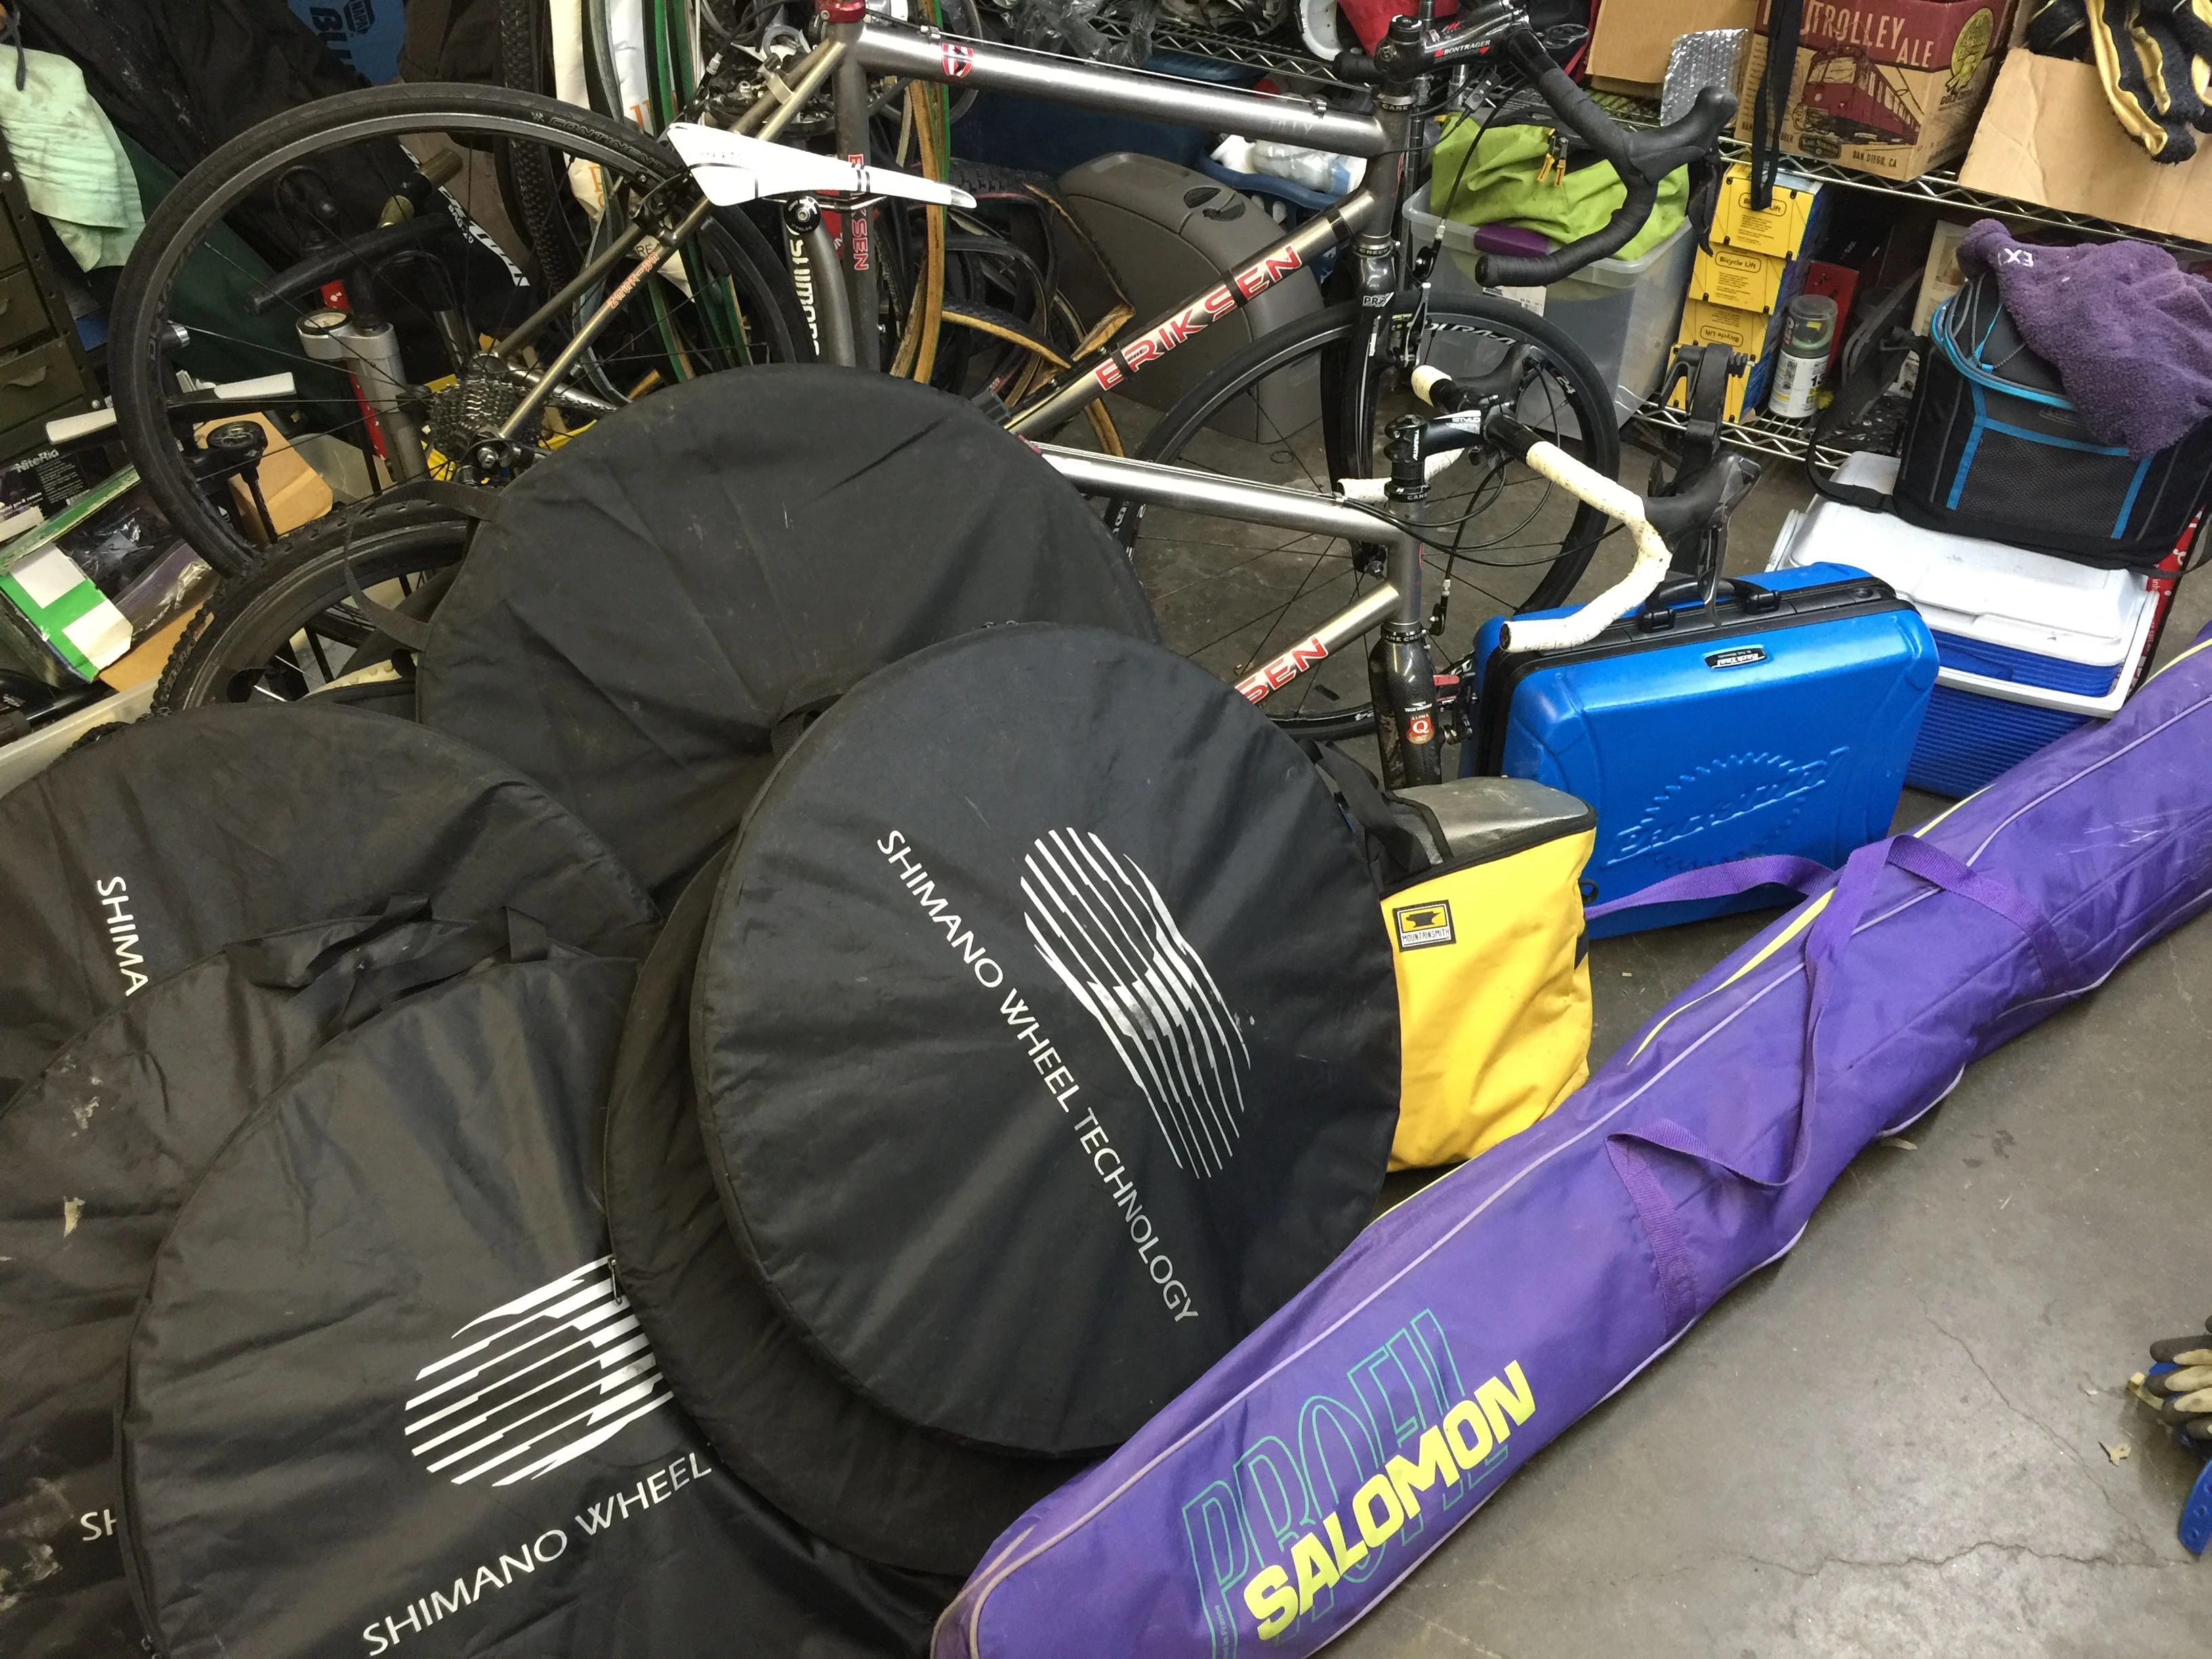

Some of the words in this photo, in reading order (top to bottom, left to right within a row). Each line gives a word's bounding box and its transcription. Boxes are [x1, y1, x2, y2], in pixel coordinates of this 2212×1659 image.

[1811, 3, 1906, 49] TROLLEY
[1443, 39, 1491, 55] BONTRAGER
[1896, 37, 1934, 68] ALE
[1852, 150, 1864, 160] SAN
[1866, 152, 1886, 167] DIEGO,
[1889, 158, 1897, 167] CA
[1719, 256, 1743, 267] Bicycle
[1744, 259, 1757, 270] Lift
[607, 251, 661, 309] ERIKSEN
[1094, 243, 1303, 392] ERIKSEN
[1704, 329, 1716, 337] Lift
[1717, 331, 1740, 343] Bicycle
[1557, 375, 1576, 394] 24
[1412, 720, 1430, 734] Q
[876, 829, 1004, 989] SHIMANO
[1000, 987, 1078, 1114] WHEEL
[1073, 1107, 1200, 1323] TECHNOLOGY
[1244, 1359, 1536, 1641] SALOMON
[363, 1528, 569, 1657] SHIMANO
[574, 1452, 712, 1537] WHEEL
